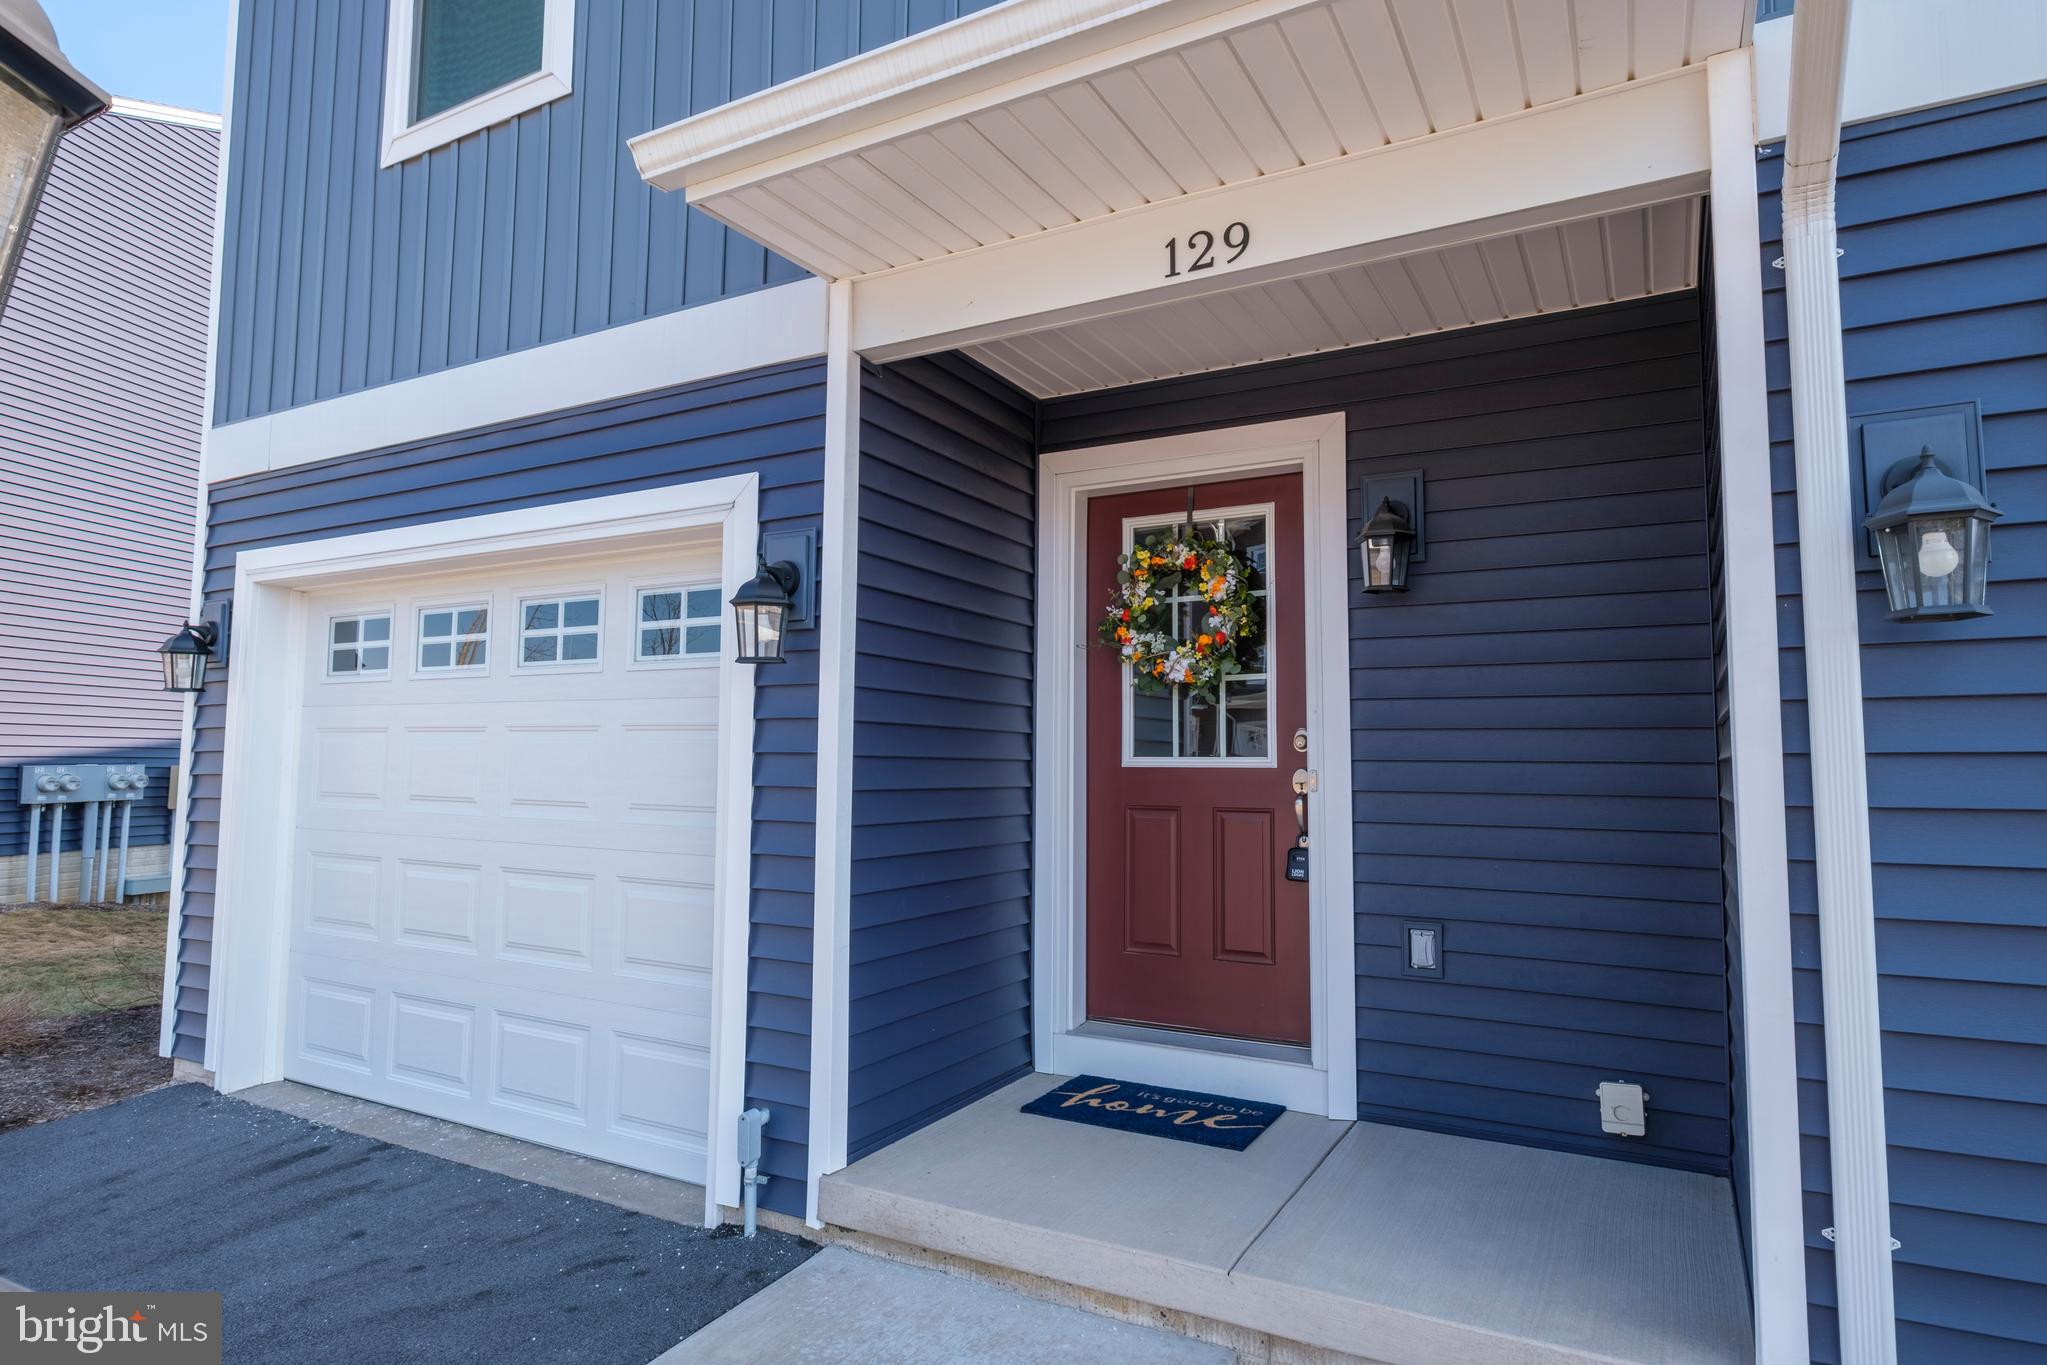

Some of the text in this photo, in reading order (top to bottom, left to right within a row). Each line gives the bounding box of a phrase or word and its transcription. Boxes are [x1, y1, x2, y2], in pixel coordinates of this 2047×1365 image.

[1165, 222, 1250, 278] 129
[1053, 1084, 1265, 1129] home
[1164, 1096, 1215, 1108] good
[1217, 1104, 1235, 1112] to
[1239, 1107, 1264, 1116] be
